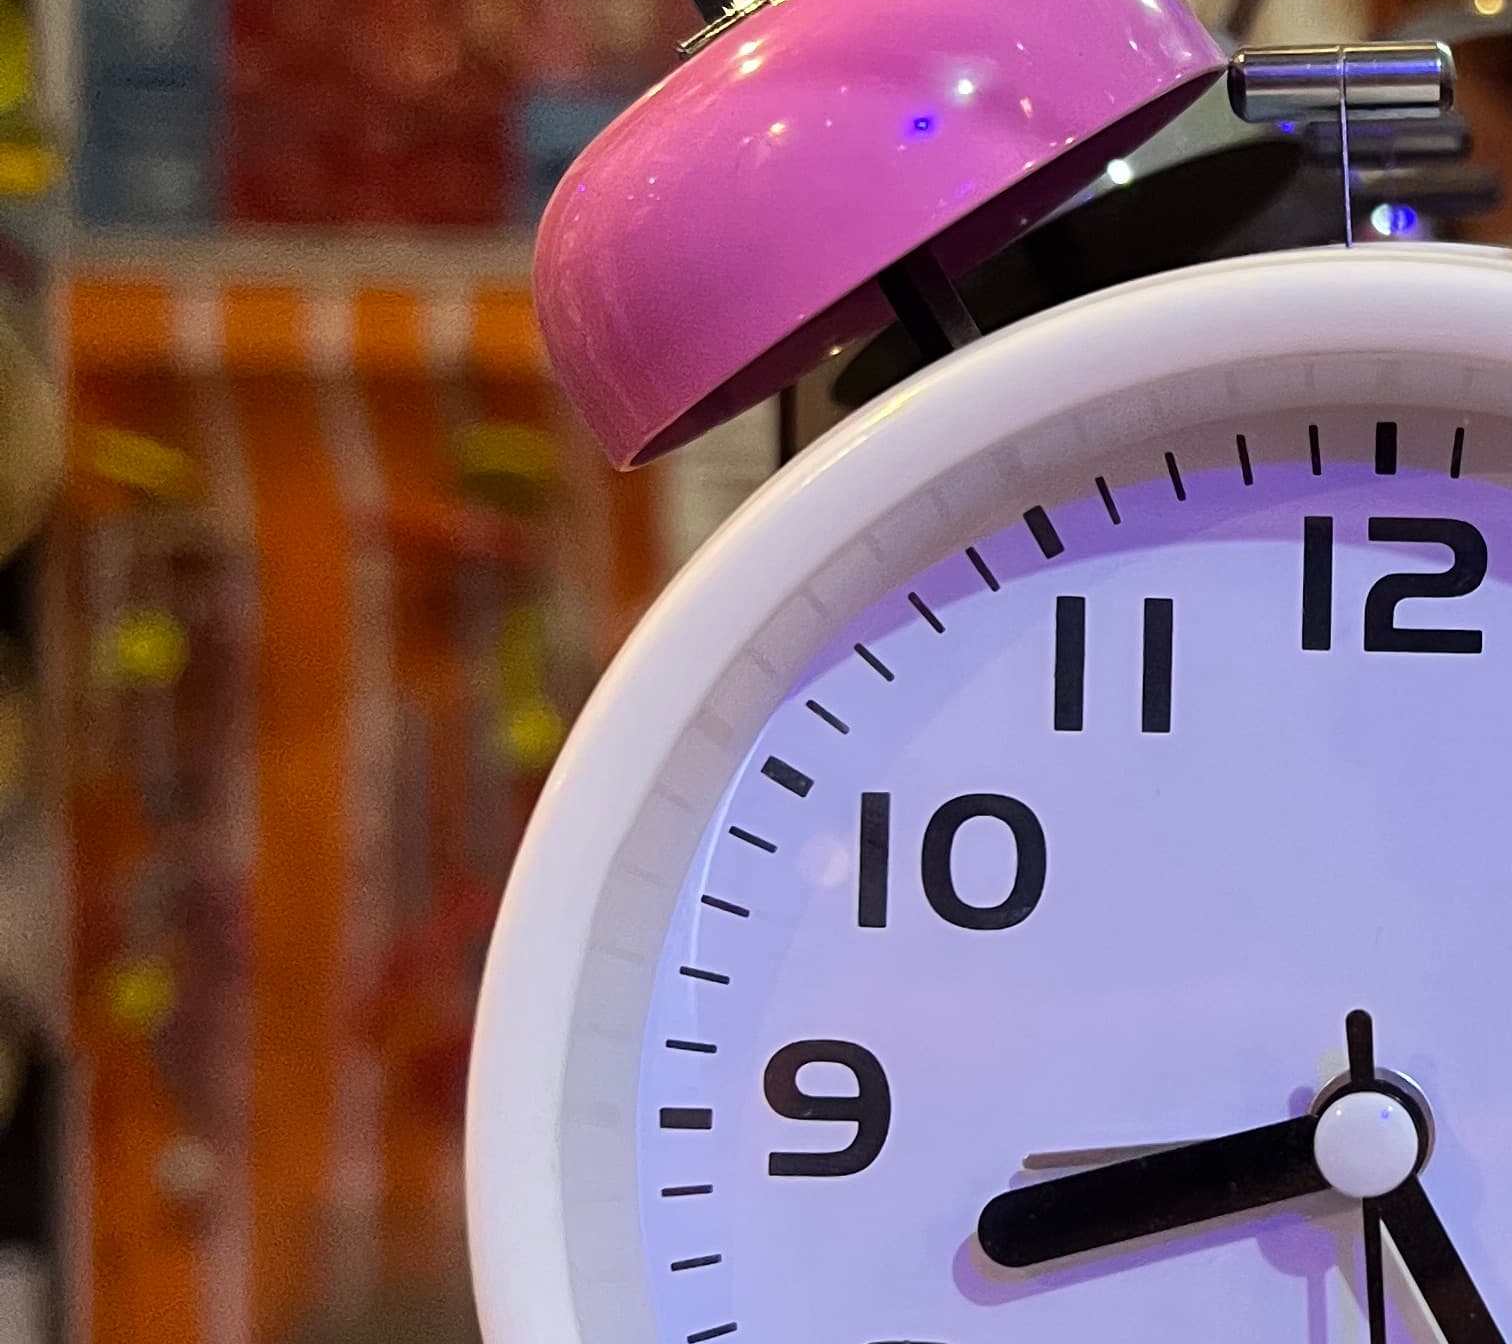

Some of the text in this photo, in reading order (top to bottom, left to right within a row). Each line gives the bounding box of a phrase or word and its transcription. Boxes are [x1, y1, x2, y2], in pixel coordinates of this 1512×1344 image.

[1301, 516, 1489, 654] 12
[1053, 595, 1174, 734] 11
[857, 791, 1047, 931] 10
[763, 1039, 892, 1178] 9
